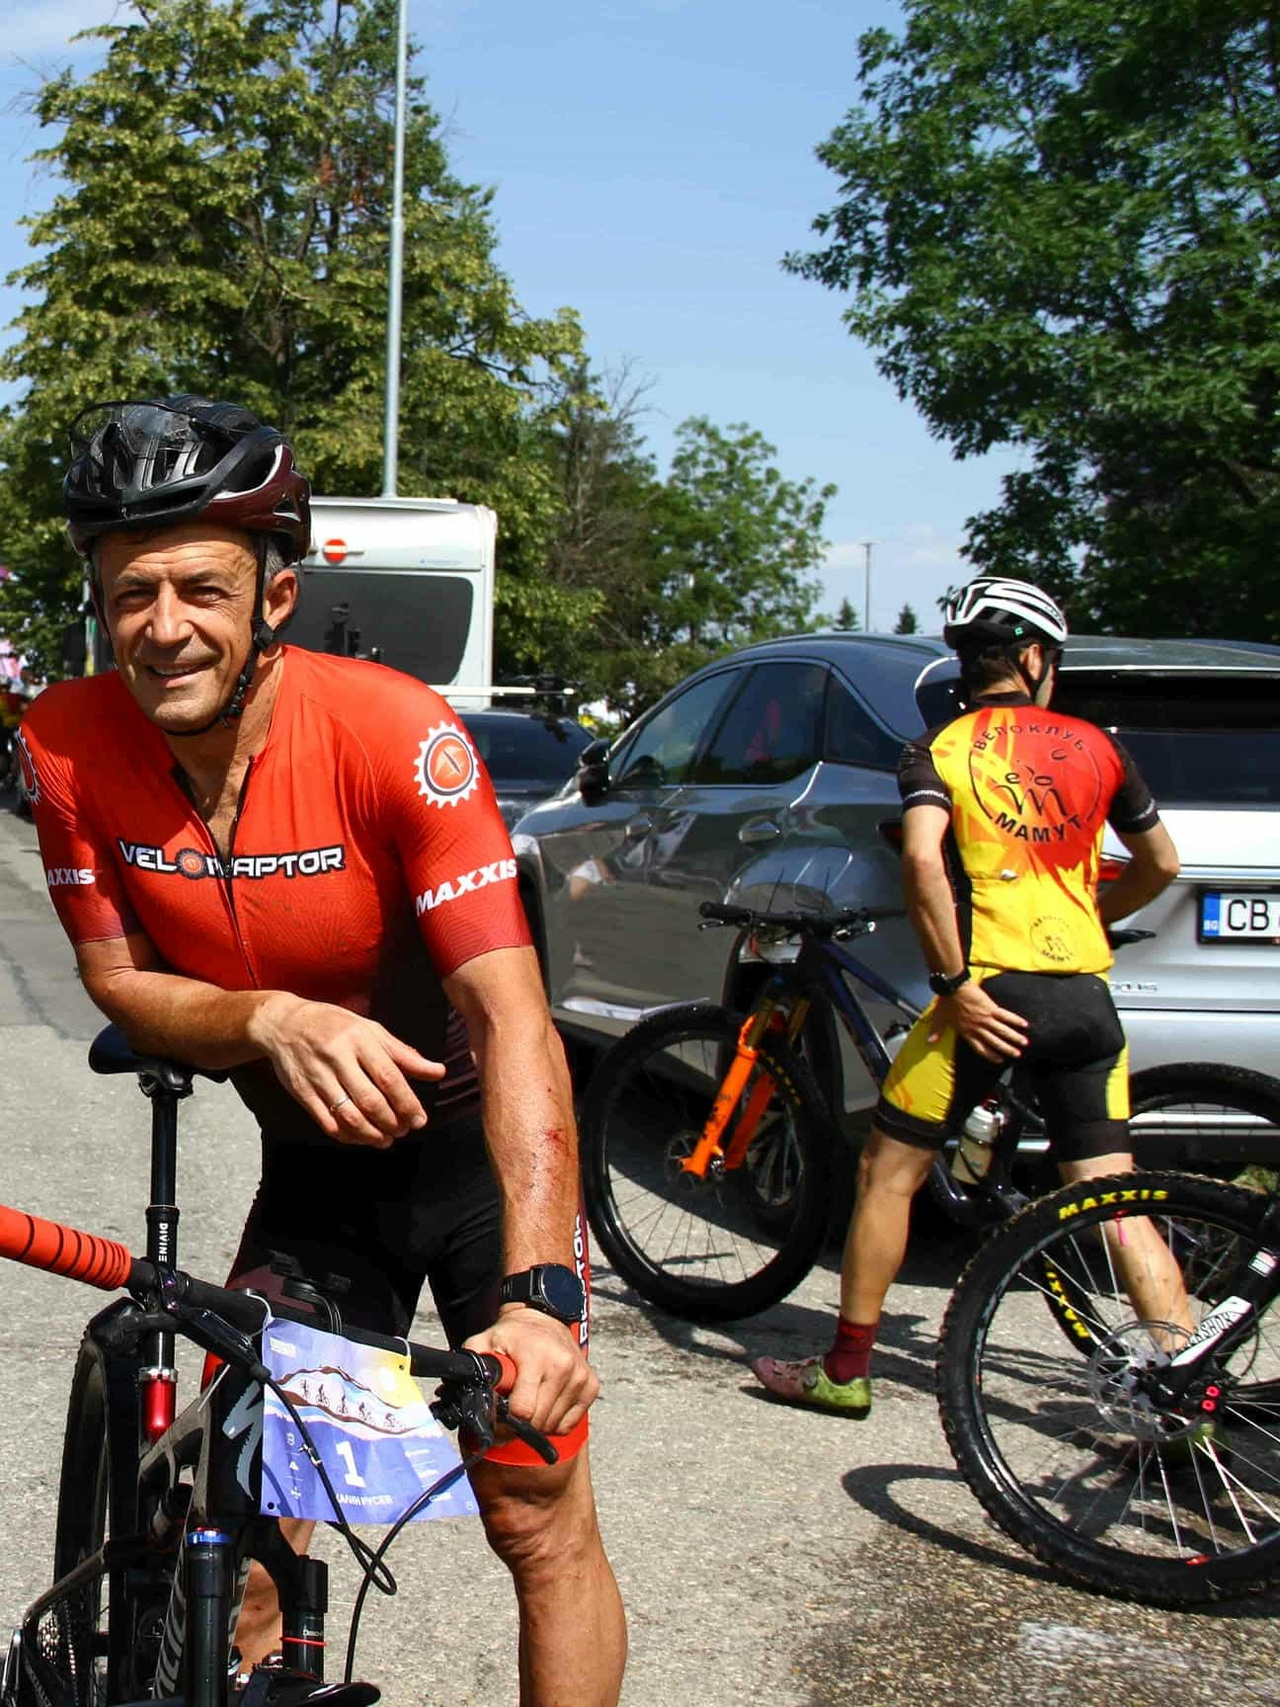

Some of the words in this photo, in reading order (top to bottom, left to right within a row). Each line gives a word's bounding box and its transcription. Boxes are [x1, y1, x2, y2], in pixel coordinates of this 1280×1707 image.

[973, 725, 1084, 751] ВЕЛОКЛУБ
[995, 812, 1082, 842] МАМУТ
[47, 868, 95, 887] AXXIS
[416, 858, 518, 917] MAXXIS
[1058, 1188, 1169, 1220] MAXXIS
[158, 1222, 169, 1263] DIVINE
[335, 1440, 366, 1489] 1
